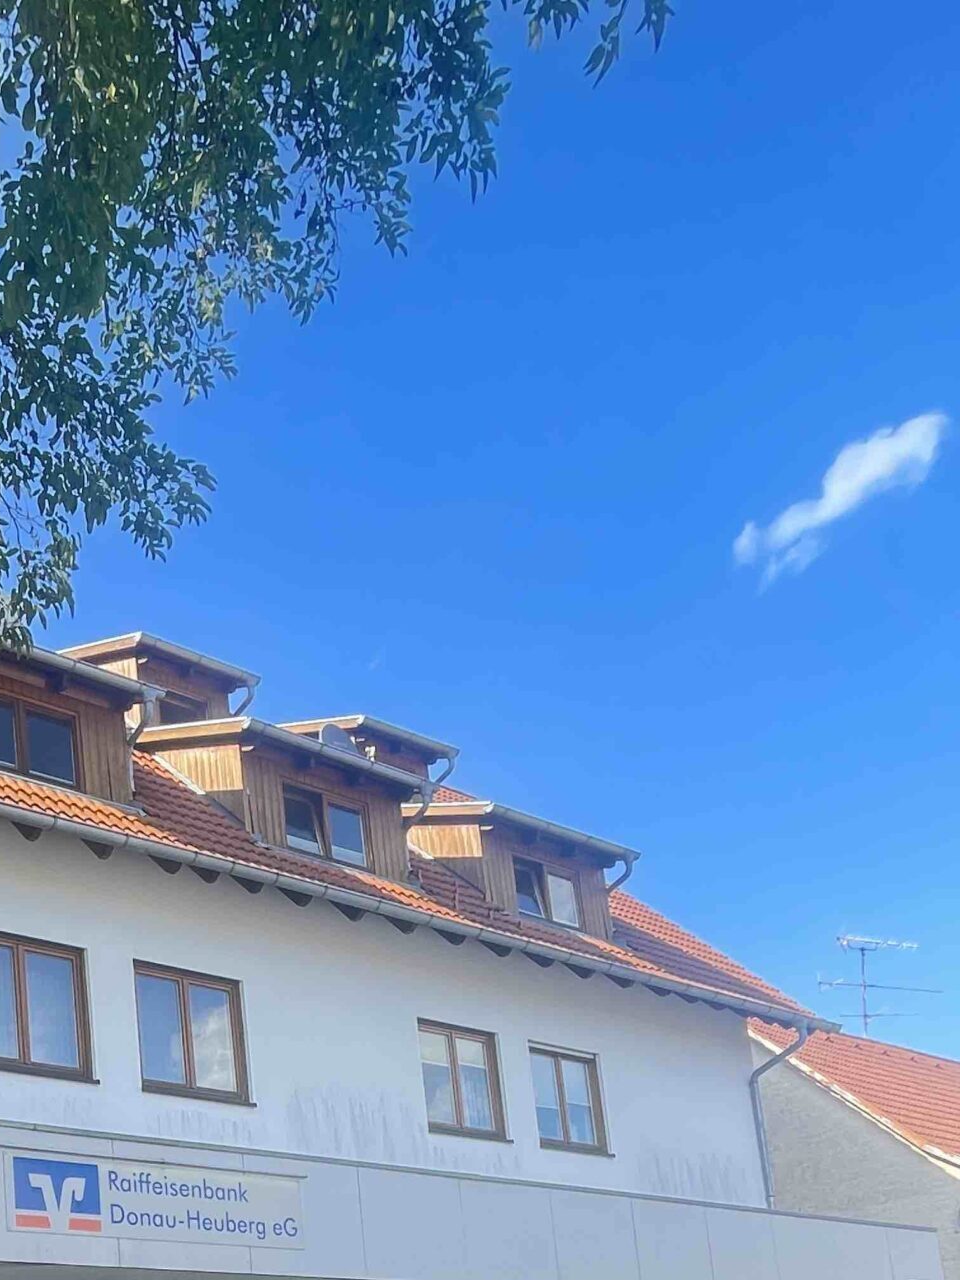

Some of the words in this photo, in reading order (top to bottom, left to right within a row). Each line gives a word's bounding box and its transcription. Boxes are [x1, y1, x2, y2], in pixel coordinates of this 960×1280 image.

[108, 1170, 248, 1202] Raiffeisenbank
[110, 1203, 266, 1240] Donau-Heuberg
[272, 1217, 298, 1237] eG
